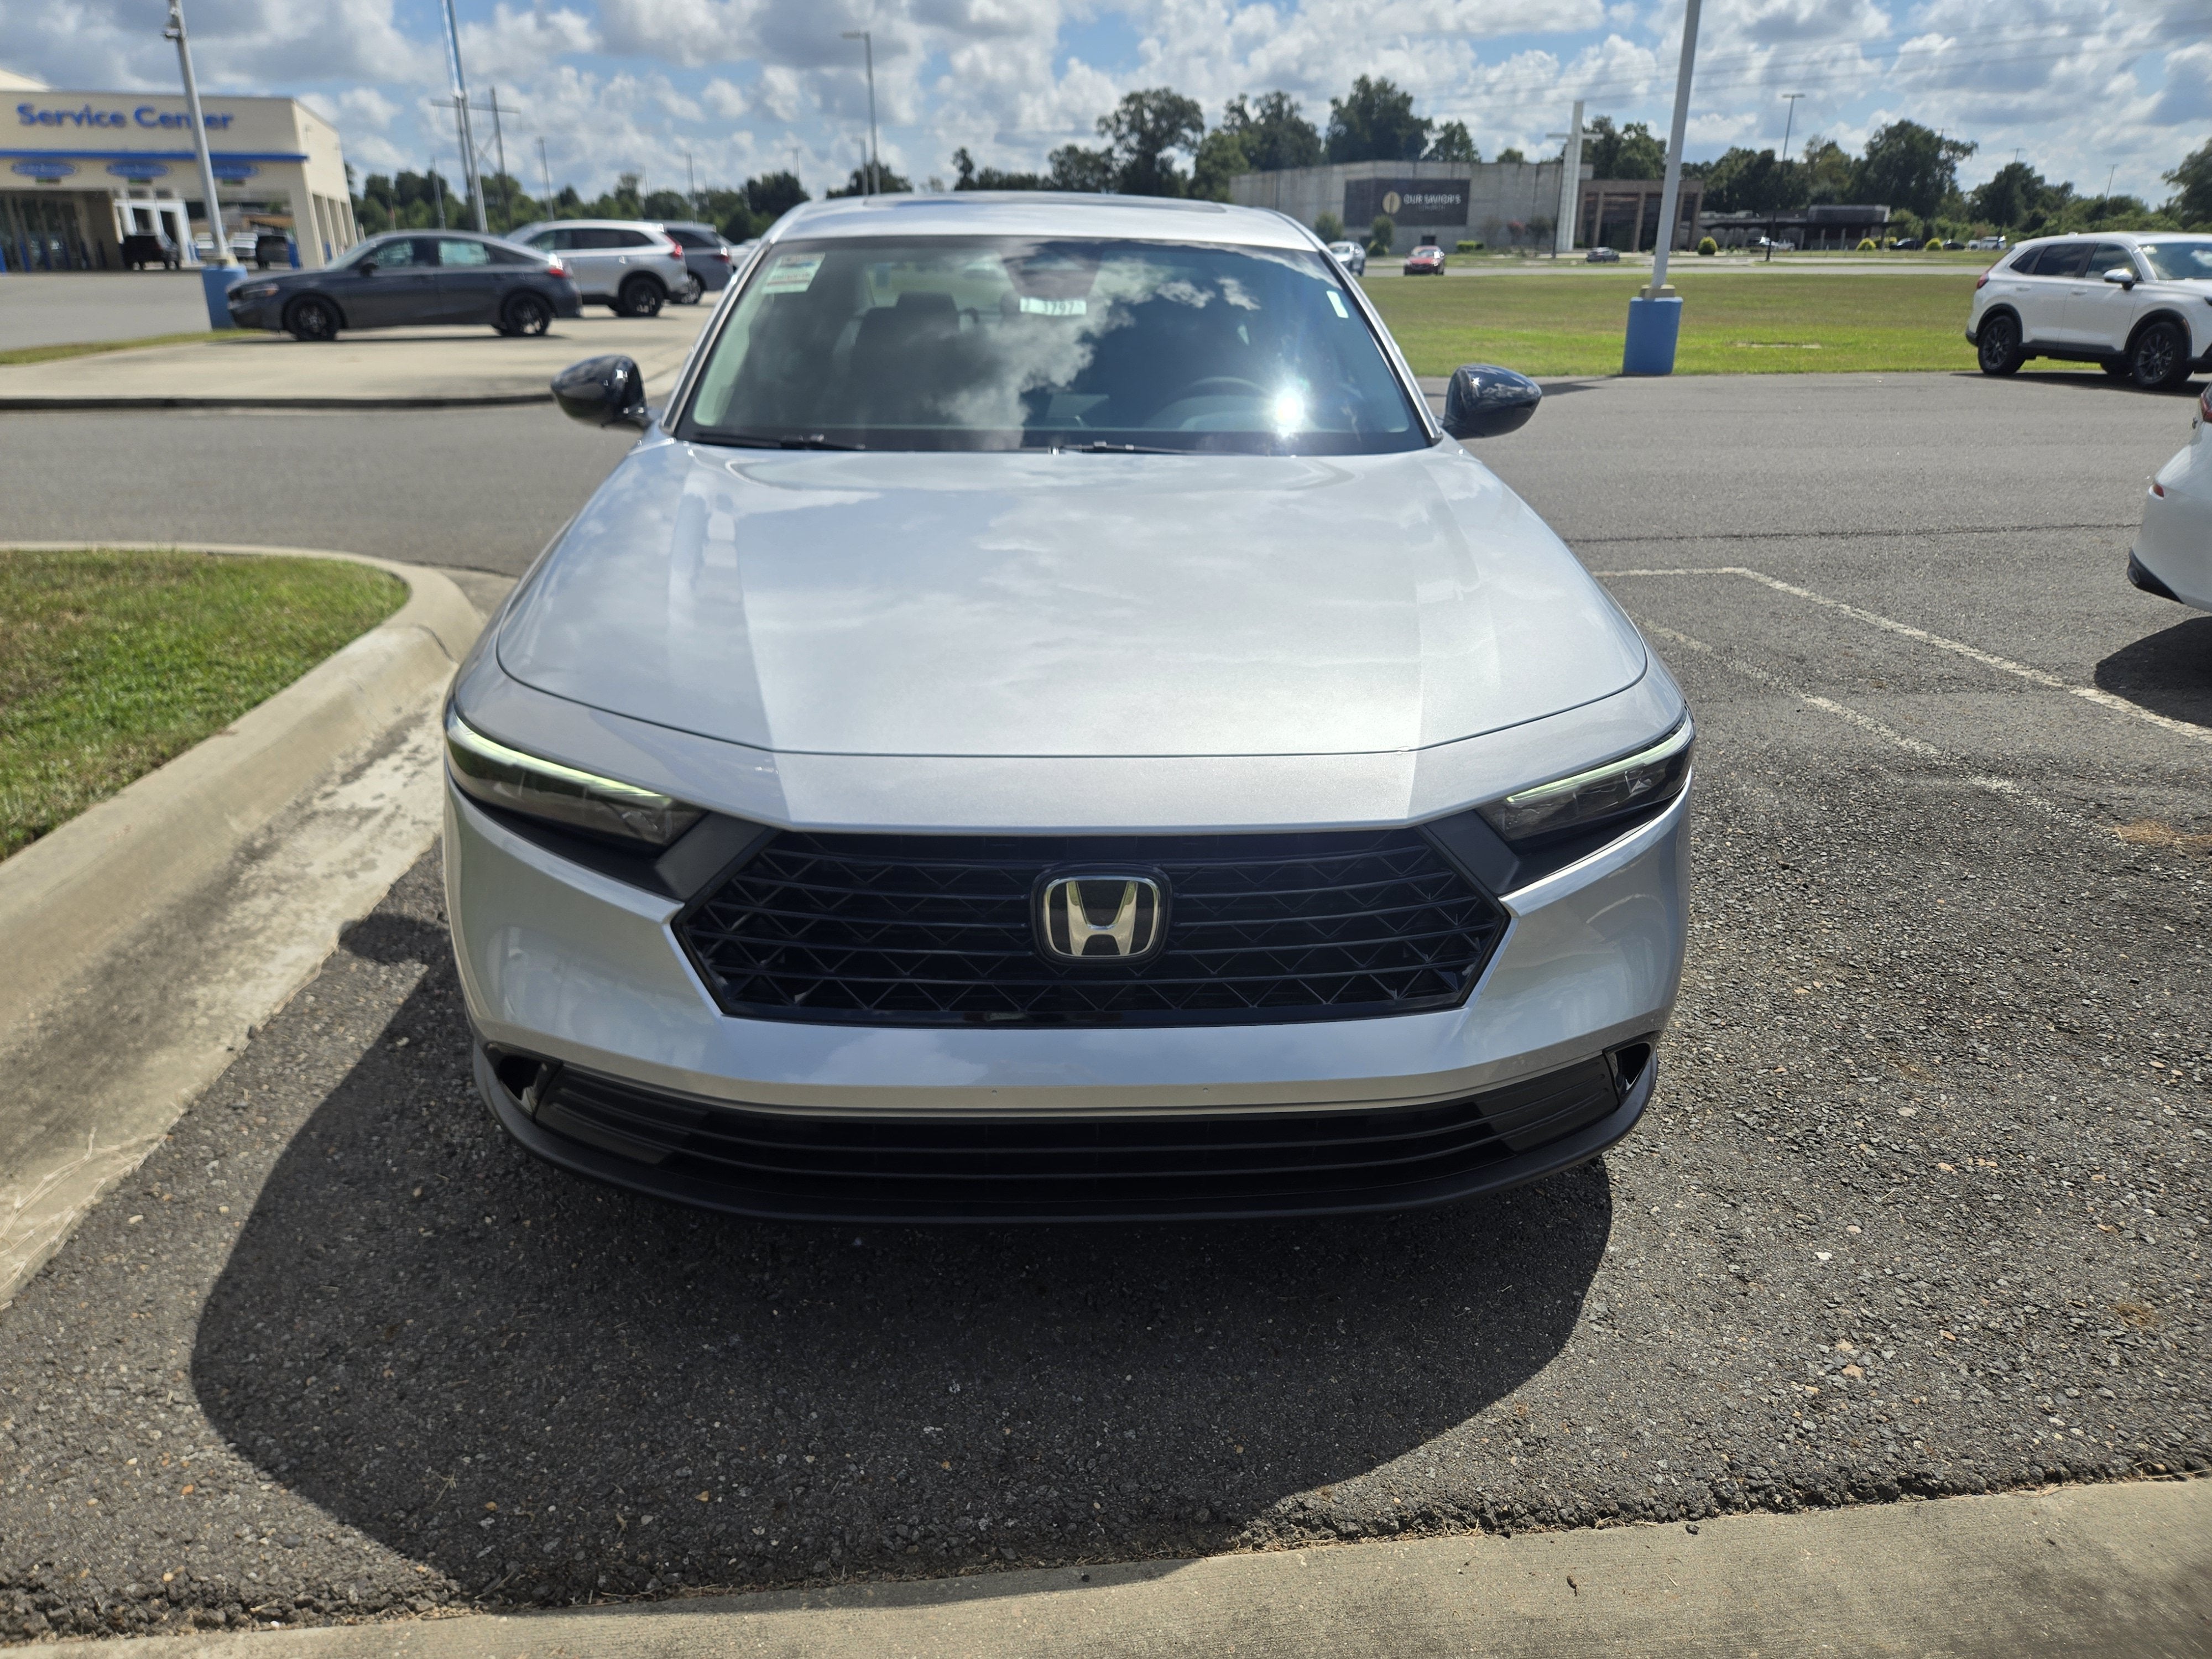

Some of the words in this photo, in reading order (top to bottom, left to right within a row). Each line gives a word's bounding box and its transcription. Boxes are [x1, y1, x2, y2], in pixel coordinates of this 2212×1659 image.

[16, 102, 127, 128] Service
[134, 105, 233, 129] Cener
[1403, 194, 1423, 205] OUR
